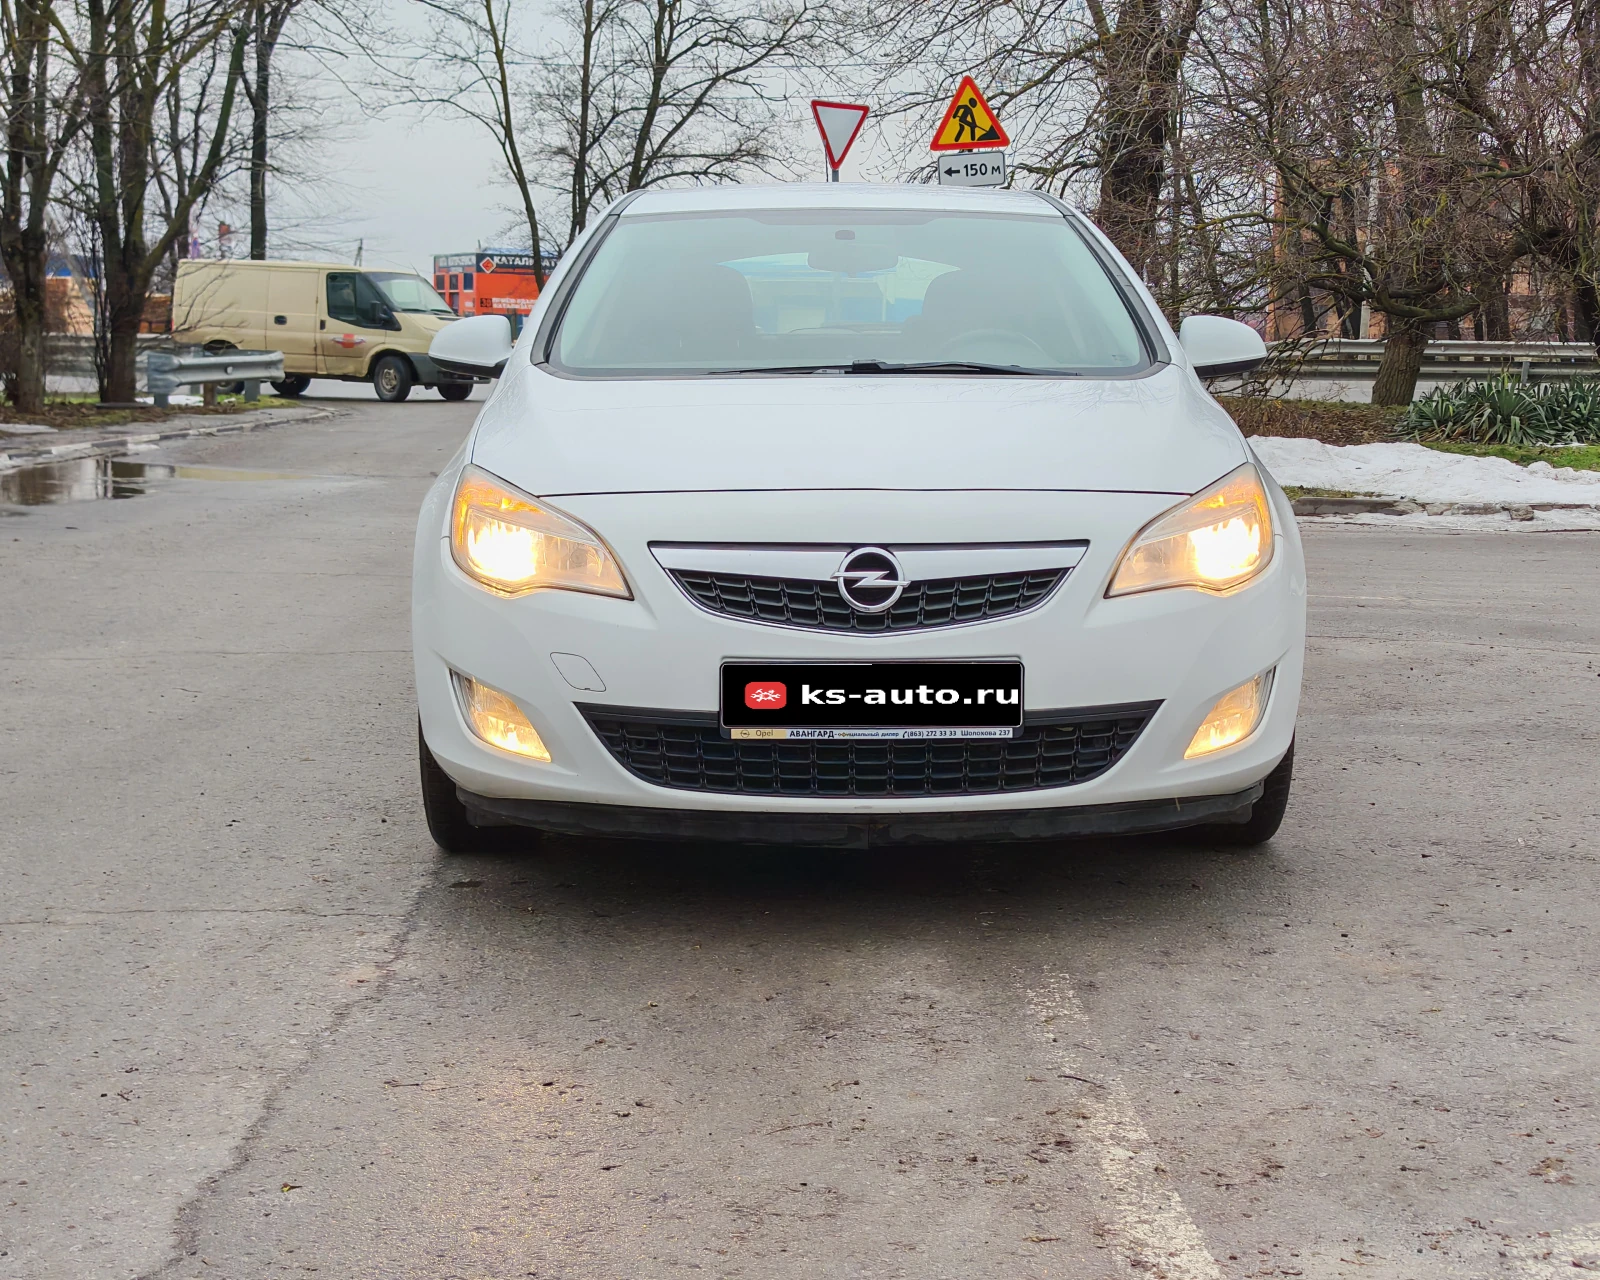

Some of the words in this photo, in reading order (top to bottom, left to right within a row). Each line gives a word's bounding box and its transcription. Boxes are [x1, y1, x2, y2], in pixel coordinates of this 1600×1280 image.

[963, 163, 988, 177] 150
[755, 730, 774, 738] Opel
[907, 730, 924, 738] (863)
